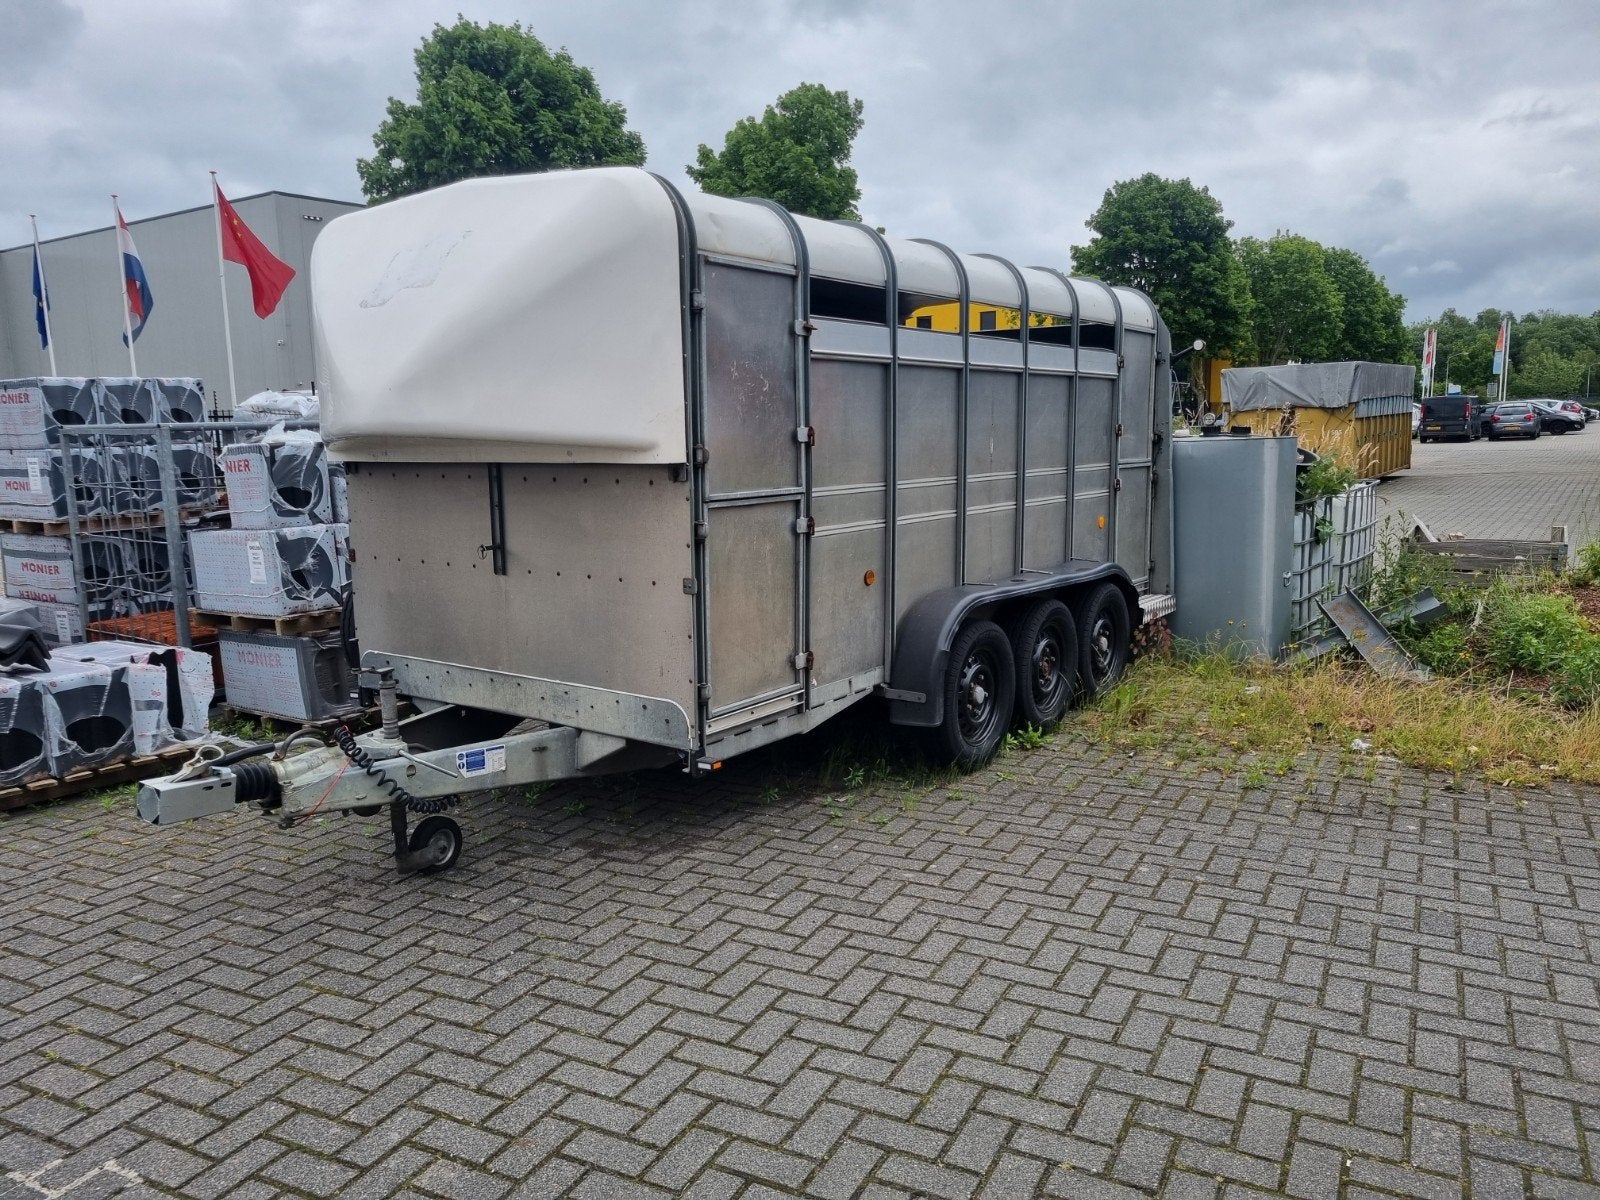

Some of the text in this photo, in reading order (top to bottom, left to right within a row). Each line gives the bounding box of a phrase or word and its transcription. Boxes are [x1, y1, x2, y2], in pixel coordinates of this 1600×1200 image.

[0, 392, 30, 404] ONIER
[225, 458, 251, 473] NIER
[4, 480, 31, 491] MONI
[21, 562, 60, 575] MONIER
[236, 650, 282, 668] MONIER
